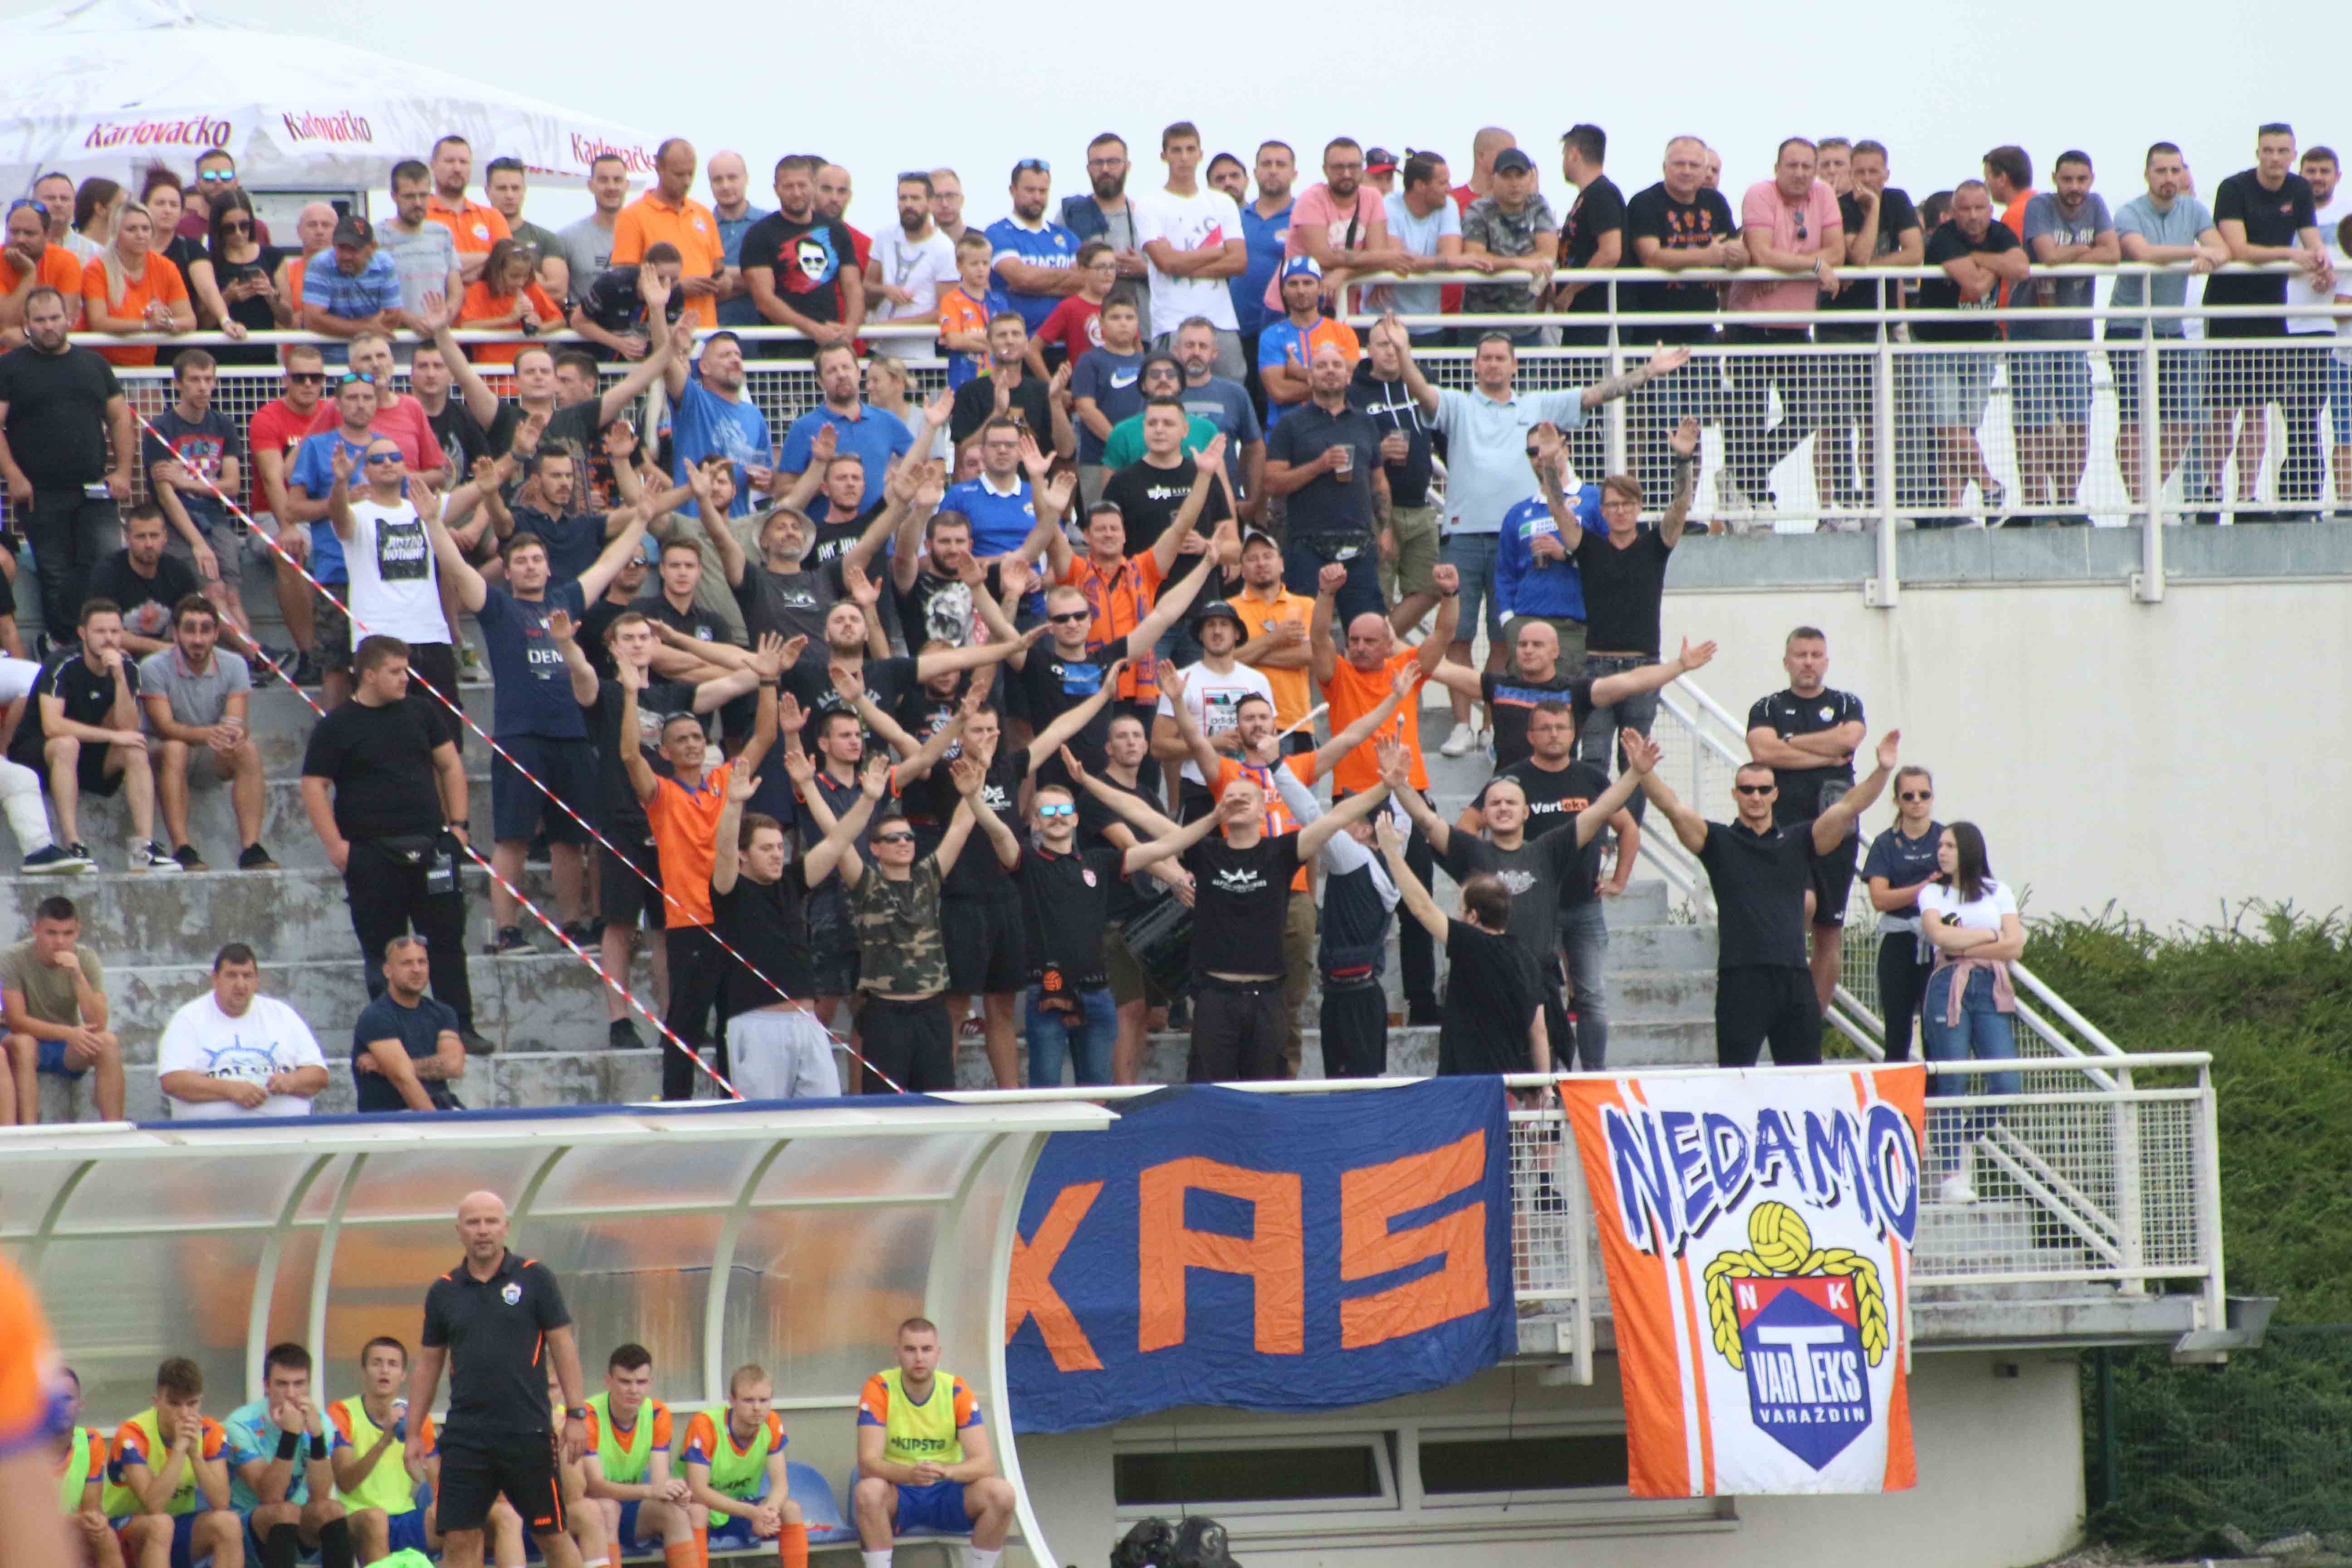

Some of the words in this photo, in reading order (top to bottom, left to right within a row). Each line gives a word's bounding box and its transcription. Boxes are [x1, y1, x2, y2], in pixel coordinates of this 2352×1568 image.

[1601, 1102, 1921, 1257] NEDAMO
[1738, 1284, 1758, 1310] N
[1828, 1283, 1850, 1309] K
[1750, 1325, 1862, 1404] VARTEKS
[1759, 1406, 1867, 1424] VARAŽDIN
